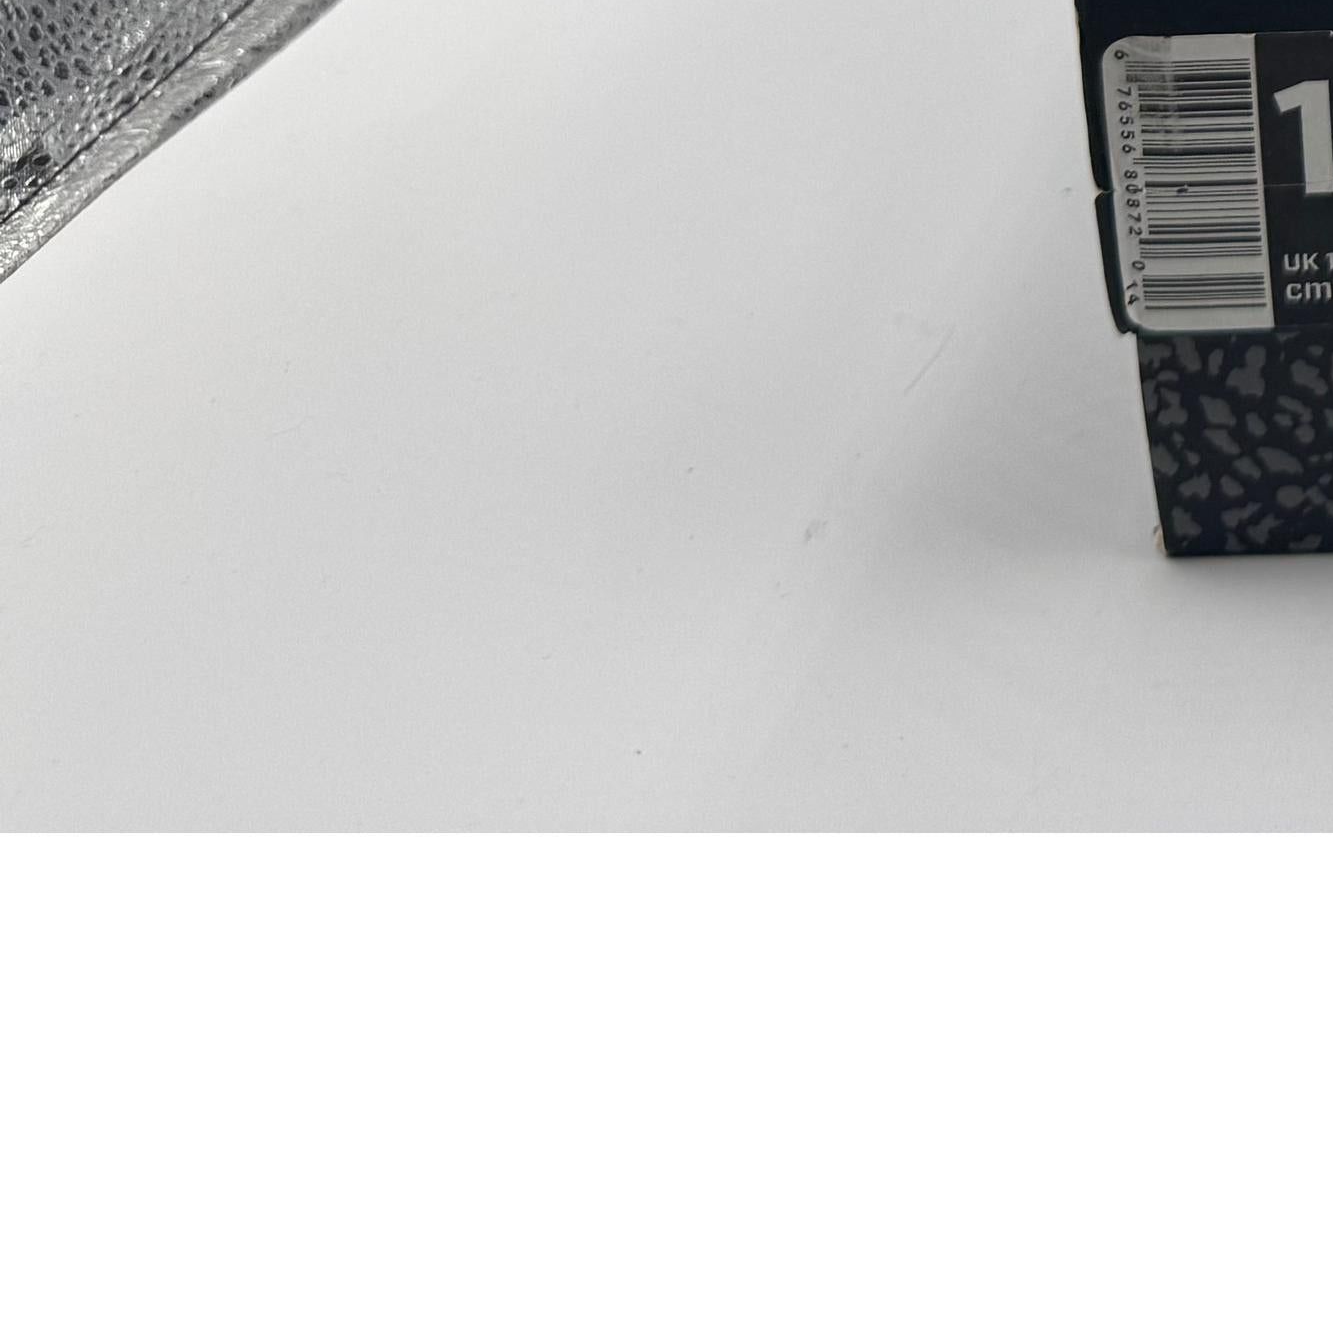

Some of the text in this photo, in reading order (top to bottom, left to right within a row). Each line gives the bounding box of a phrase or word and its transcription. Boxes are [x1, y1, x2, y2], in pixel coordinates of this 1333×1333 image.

[1116, 86, 1136, 154] 76556
[1132, 260, 1146, 271] 0
[1284, 252, 1319, 272] UK
